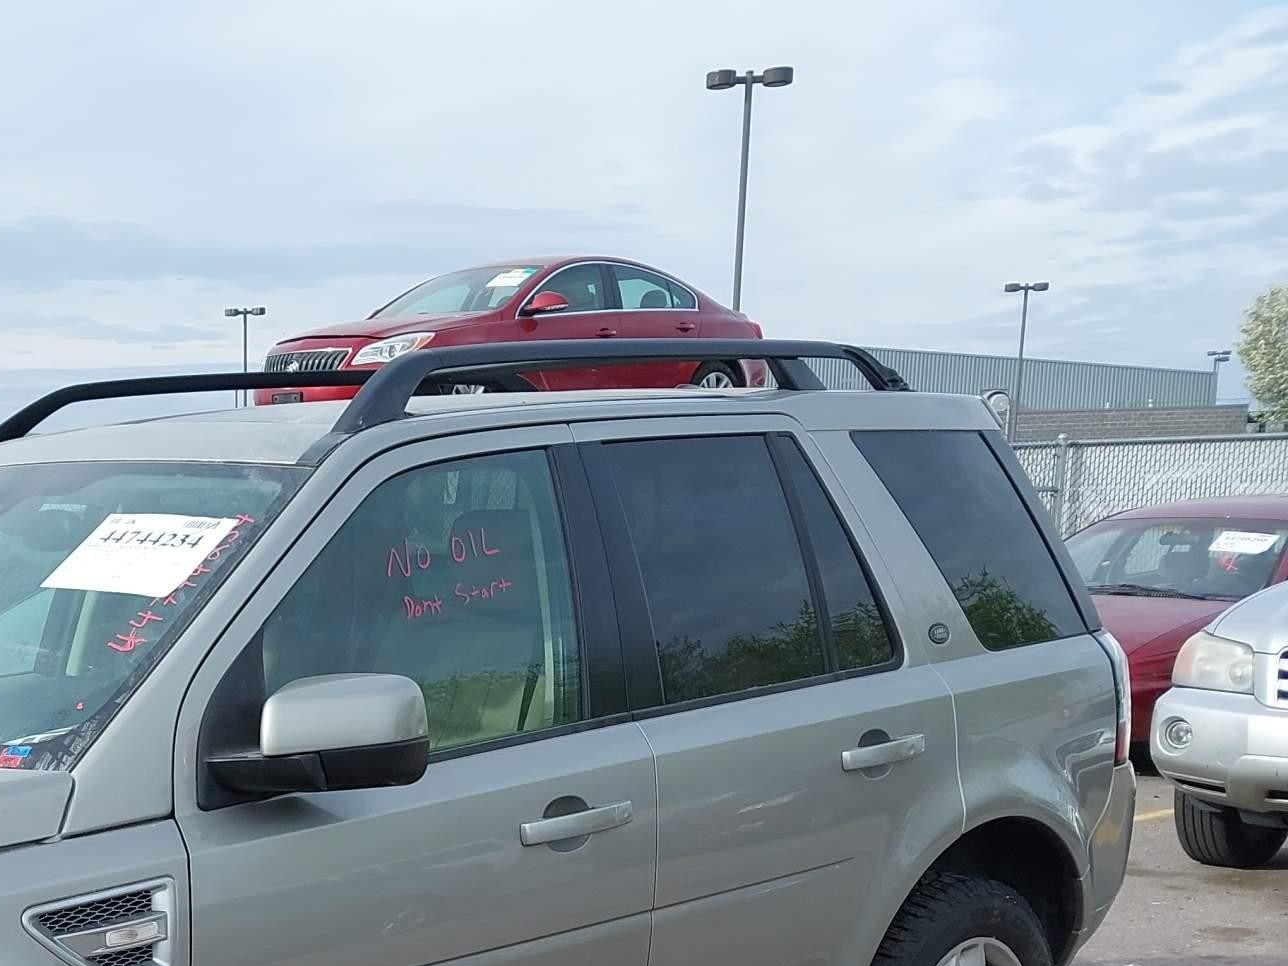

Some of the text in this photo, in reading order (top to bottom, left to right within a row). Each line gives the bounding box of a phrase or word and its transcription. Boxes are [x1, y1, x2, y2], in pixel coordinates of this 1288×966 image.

[99, 529, 205, 549] 44744234
[387, 527, 500, 576] NO OIL
[455, 577, 512, 606] Start
